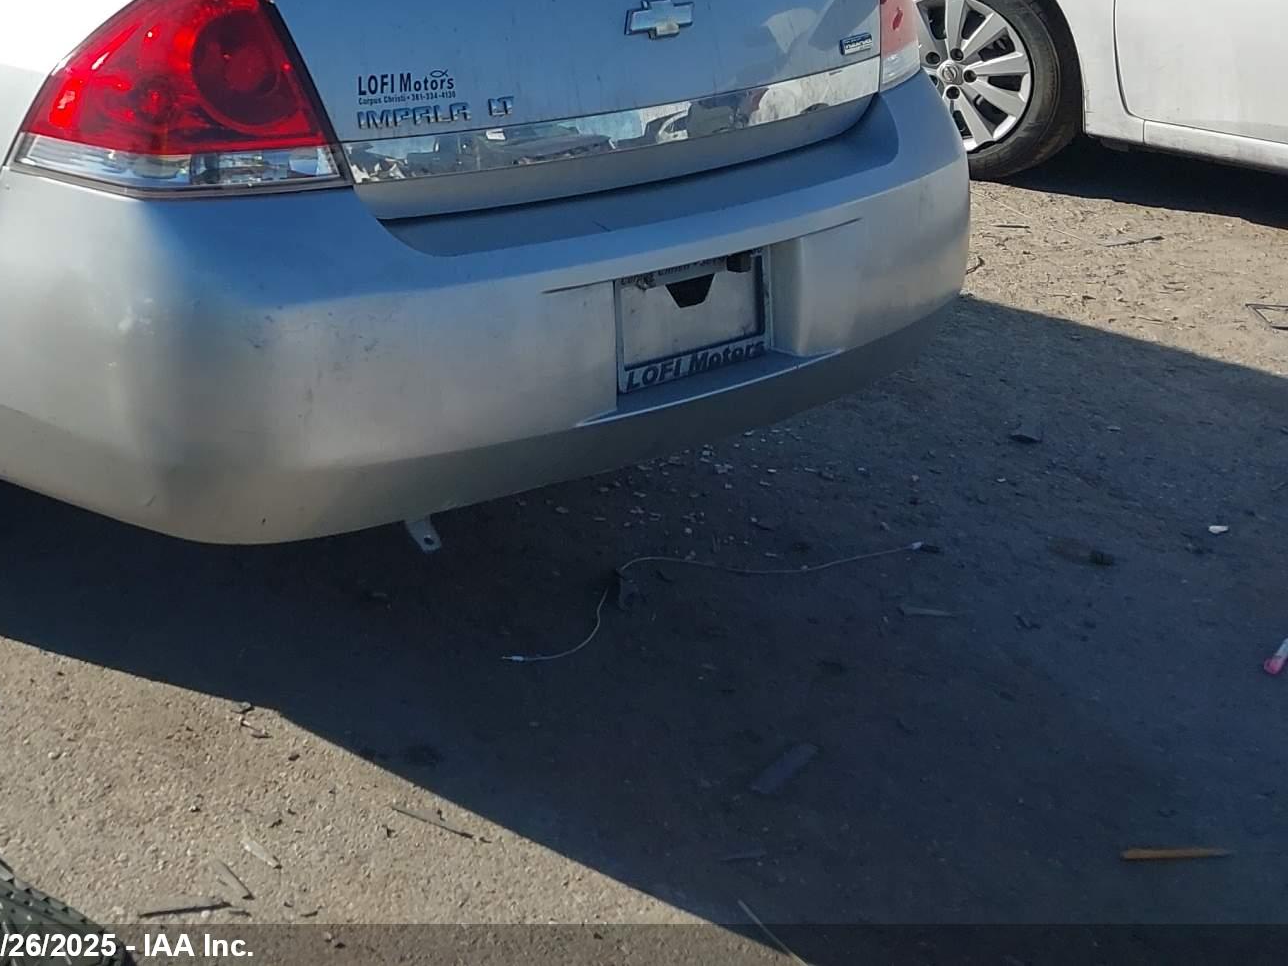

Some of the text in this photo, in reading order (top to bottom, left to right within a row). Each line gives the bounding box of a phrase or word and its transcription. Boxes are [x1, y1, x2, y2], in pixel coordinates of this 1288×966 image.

[358, 72, 455, 96] LOFI Motors
[356, 96, 515, 129] IMPALA LT
[626, 341, 765, 391] LOFI Motors
